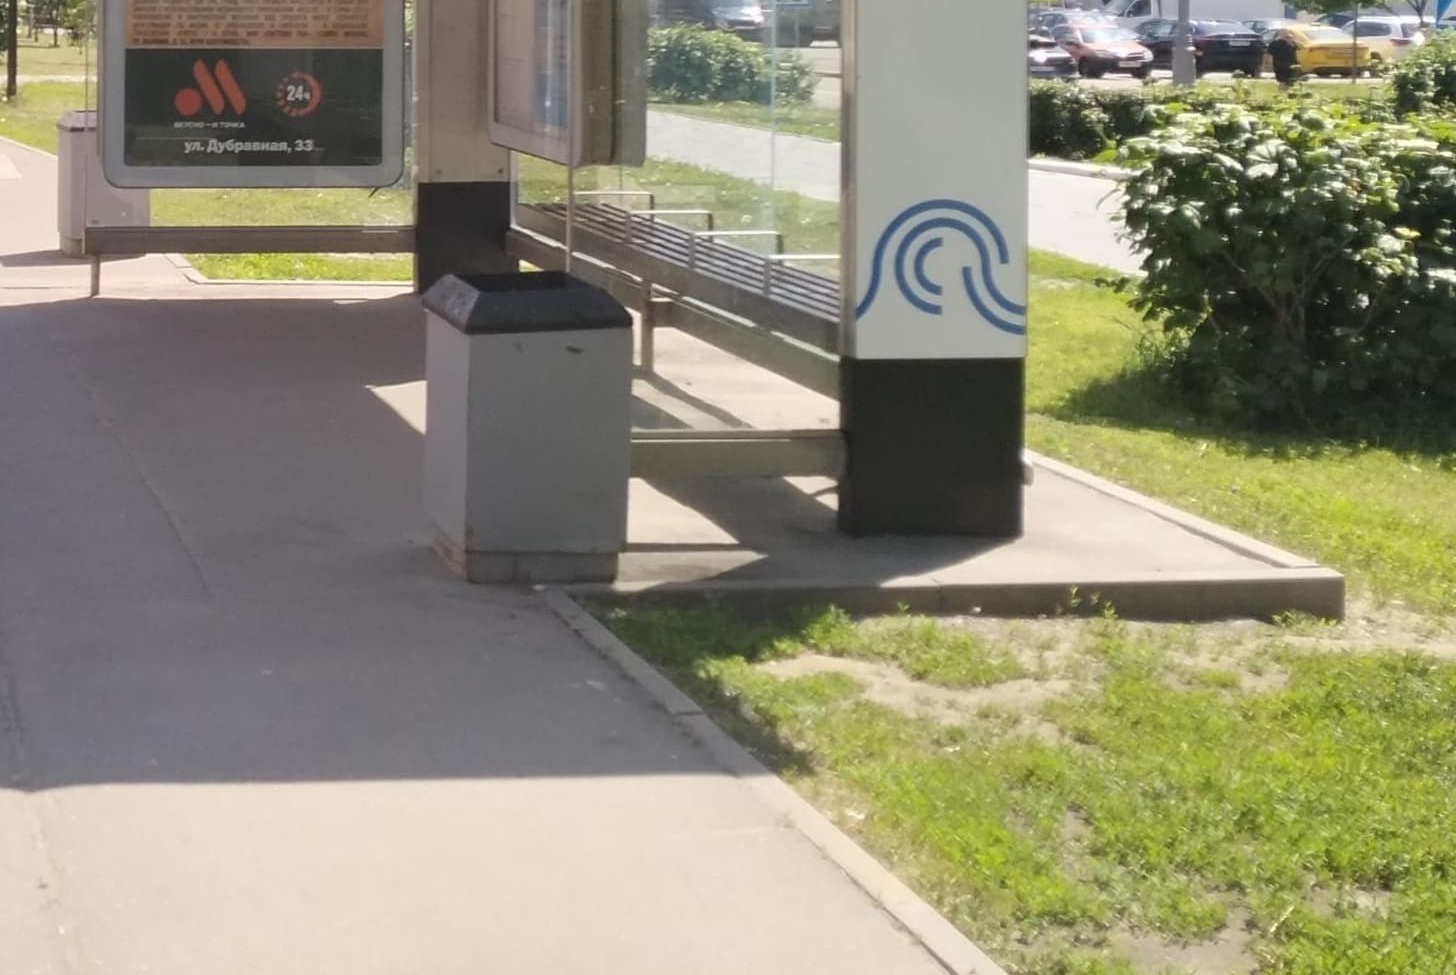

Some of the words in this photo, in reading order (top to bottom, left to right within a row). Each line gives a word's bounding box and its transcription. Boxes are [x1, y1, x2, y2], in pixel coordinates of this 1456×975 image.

[184, 140, 205, 153] ул.
[207, 138, 292, 154] Дубравная,
[294, 139, 314, 152] 33
